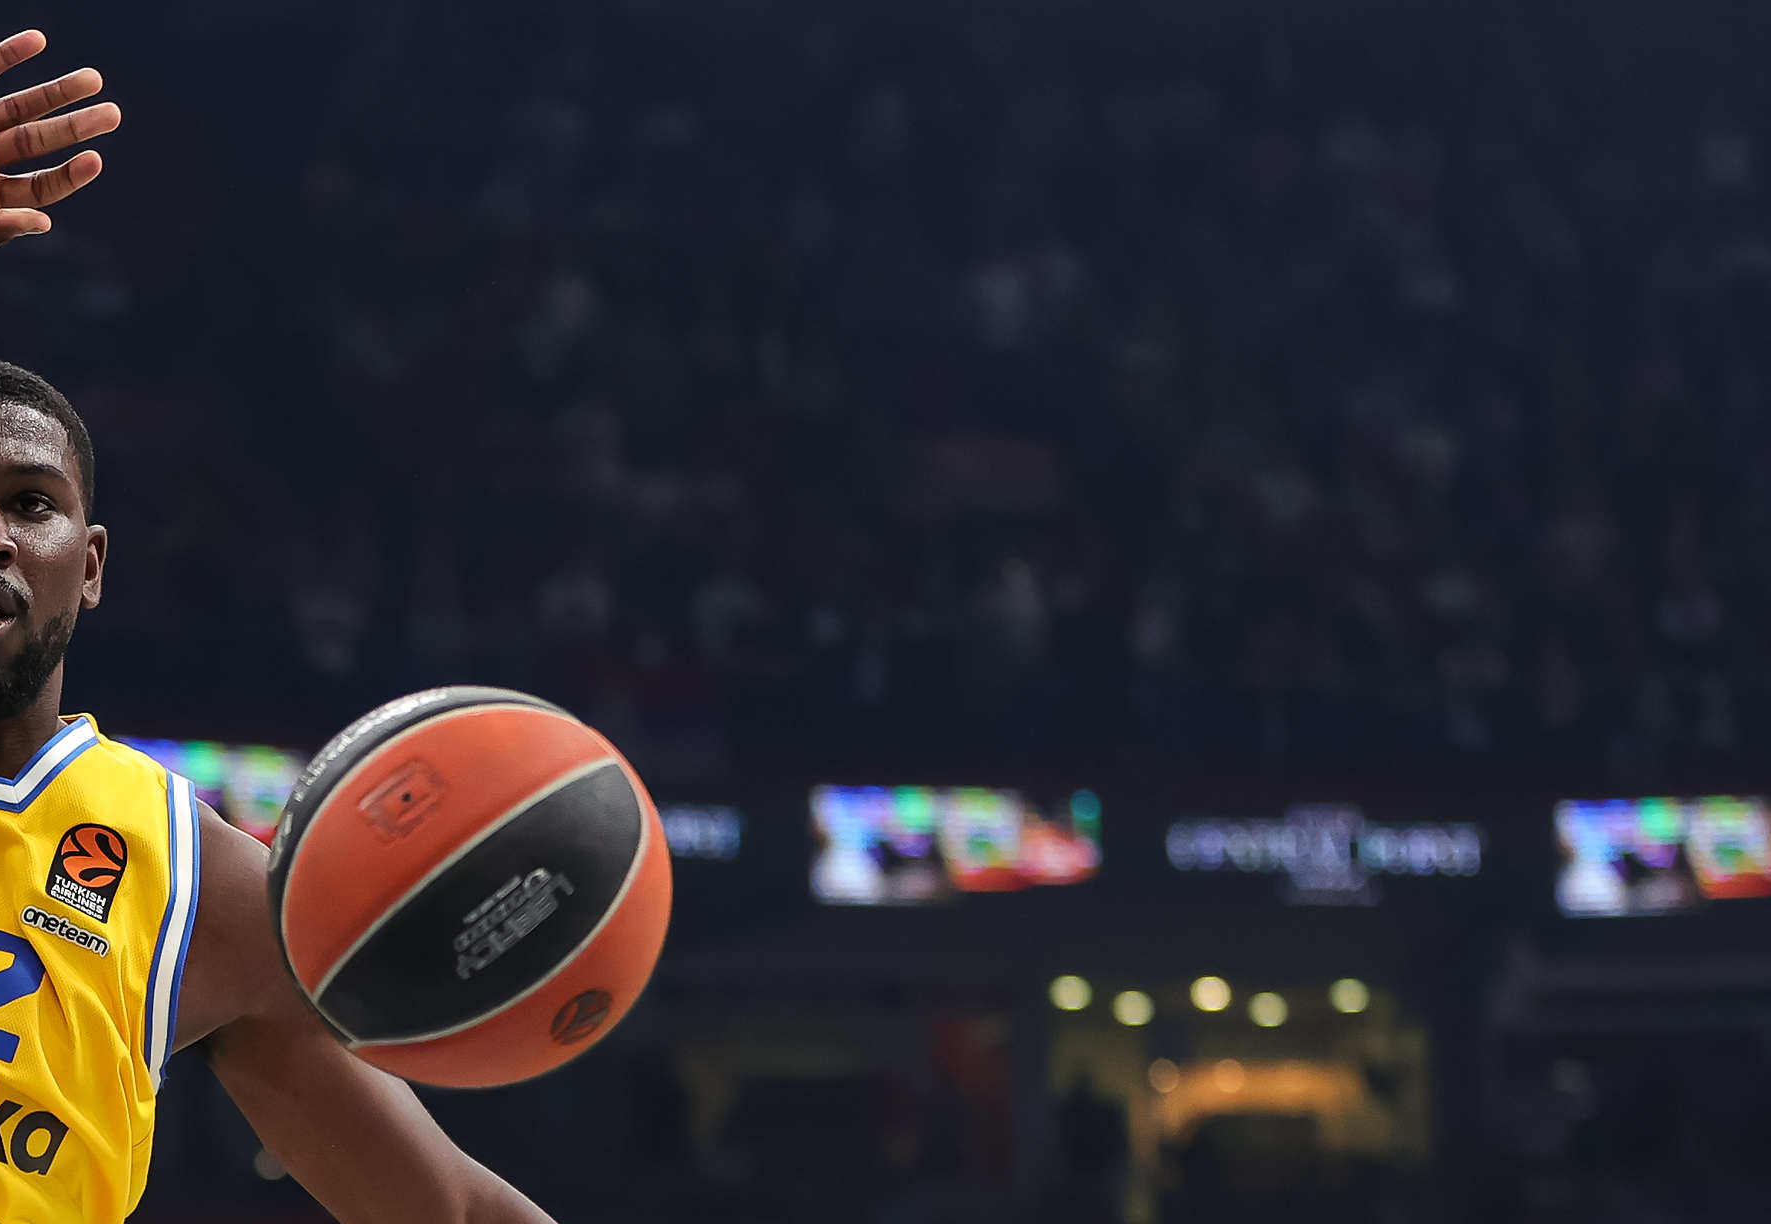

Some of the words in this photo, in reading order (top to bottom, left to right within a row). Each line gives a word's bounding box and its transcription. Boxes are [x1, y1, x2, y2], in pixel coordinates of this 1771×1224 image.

[51, 884, 104, 915] AIRLINES
[54, 874, 107, 907] TURKISH
[23, 907, 109, 956] oneteam
